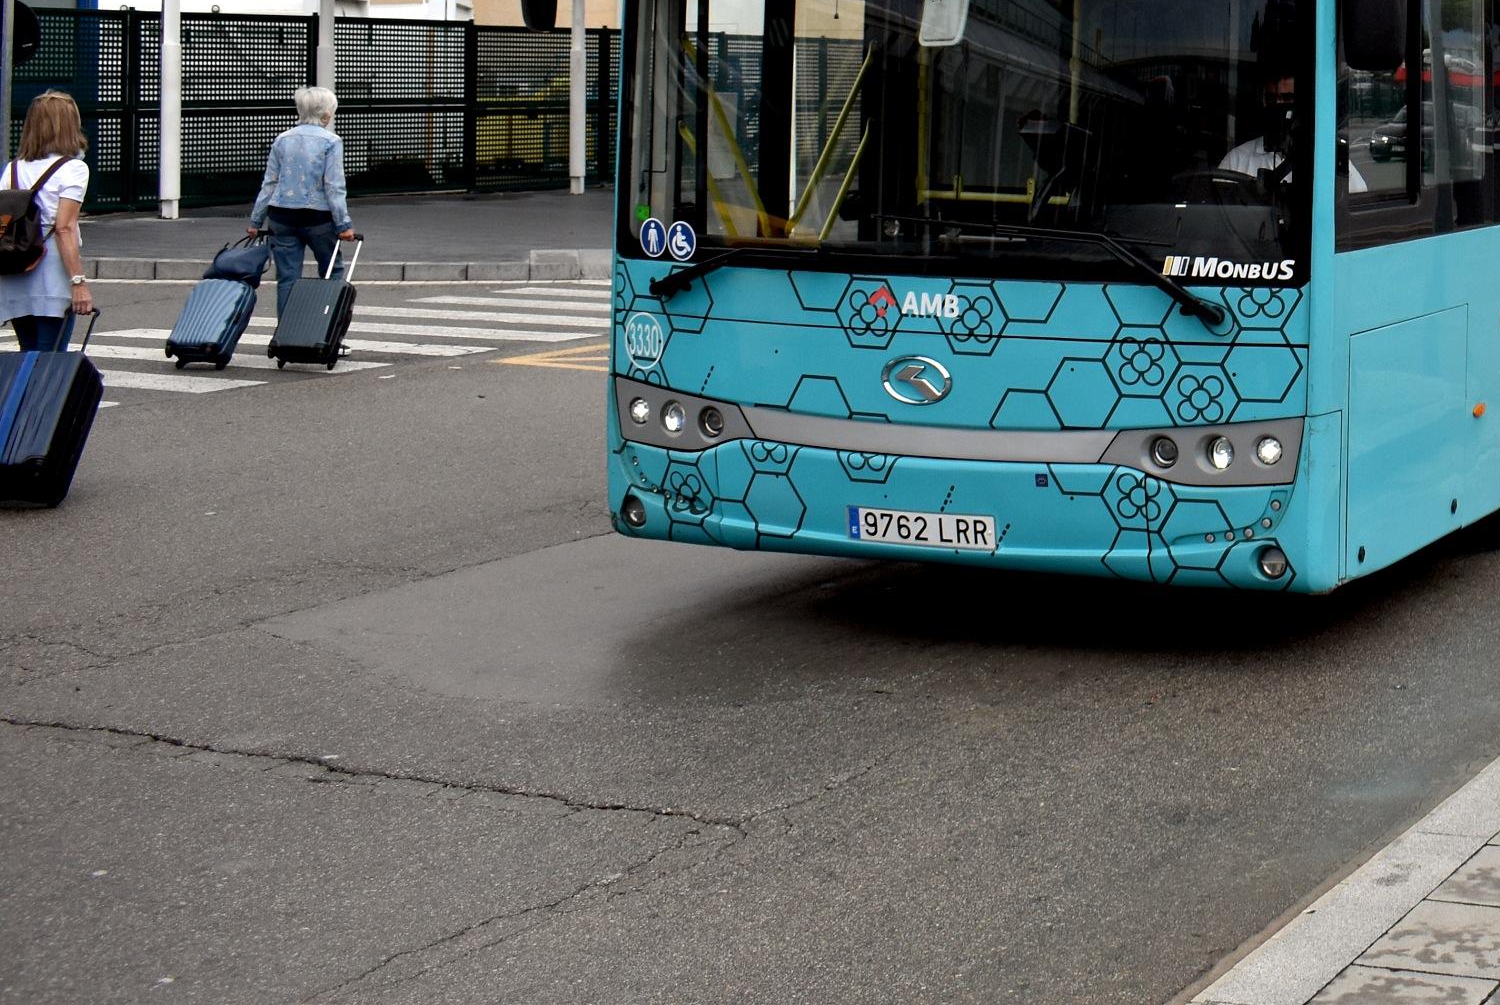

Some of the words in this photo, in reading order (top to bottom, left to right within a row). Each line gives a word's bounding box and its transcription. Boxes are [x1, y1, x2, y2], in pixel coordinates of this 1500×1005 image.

[1191, 256, 1296, 280] MONBUS
[901, 291, 959, 318] AMB
[629, 322, 659, 357] 3330
[864, 512, 928, 541] 9762
[938, 517, 988, 545] LRR
